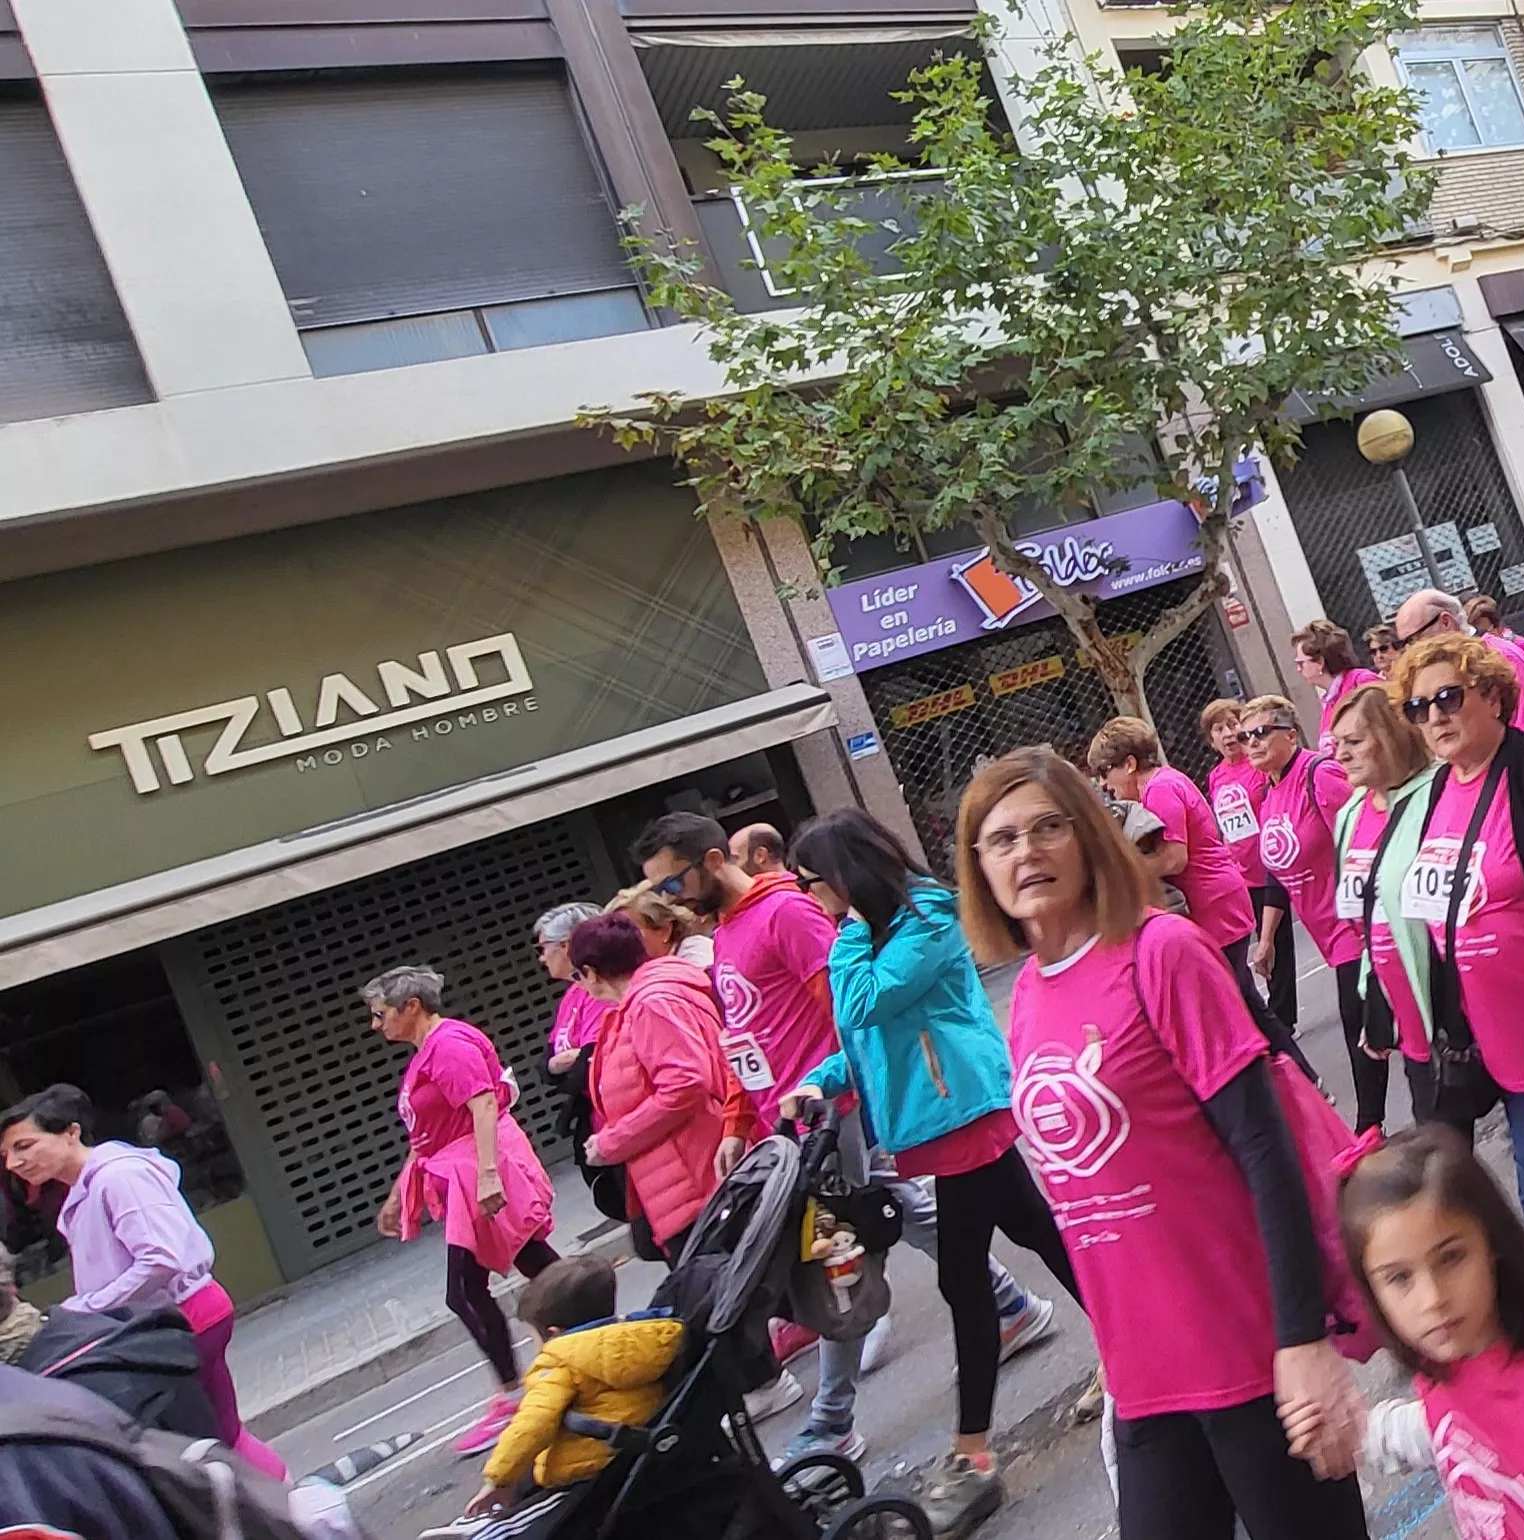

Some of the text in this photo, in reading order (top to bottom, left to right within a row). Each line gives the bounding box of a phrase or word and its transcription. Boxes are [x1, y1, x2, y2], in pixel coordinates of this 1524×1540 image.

[860, 581, 919, 614] Líder
[852, 615, 958, 662] Papelería
[879, 607, 909, 631] en
[87, 631, 534, 795] TIZIANO
[296, 696, 540, 773] MODA HOMBRE
[1222, 811, 1252, 833] 1721
